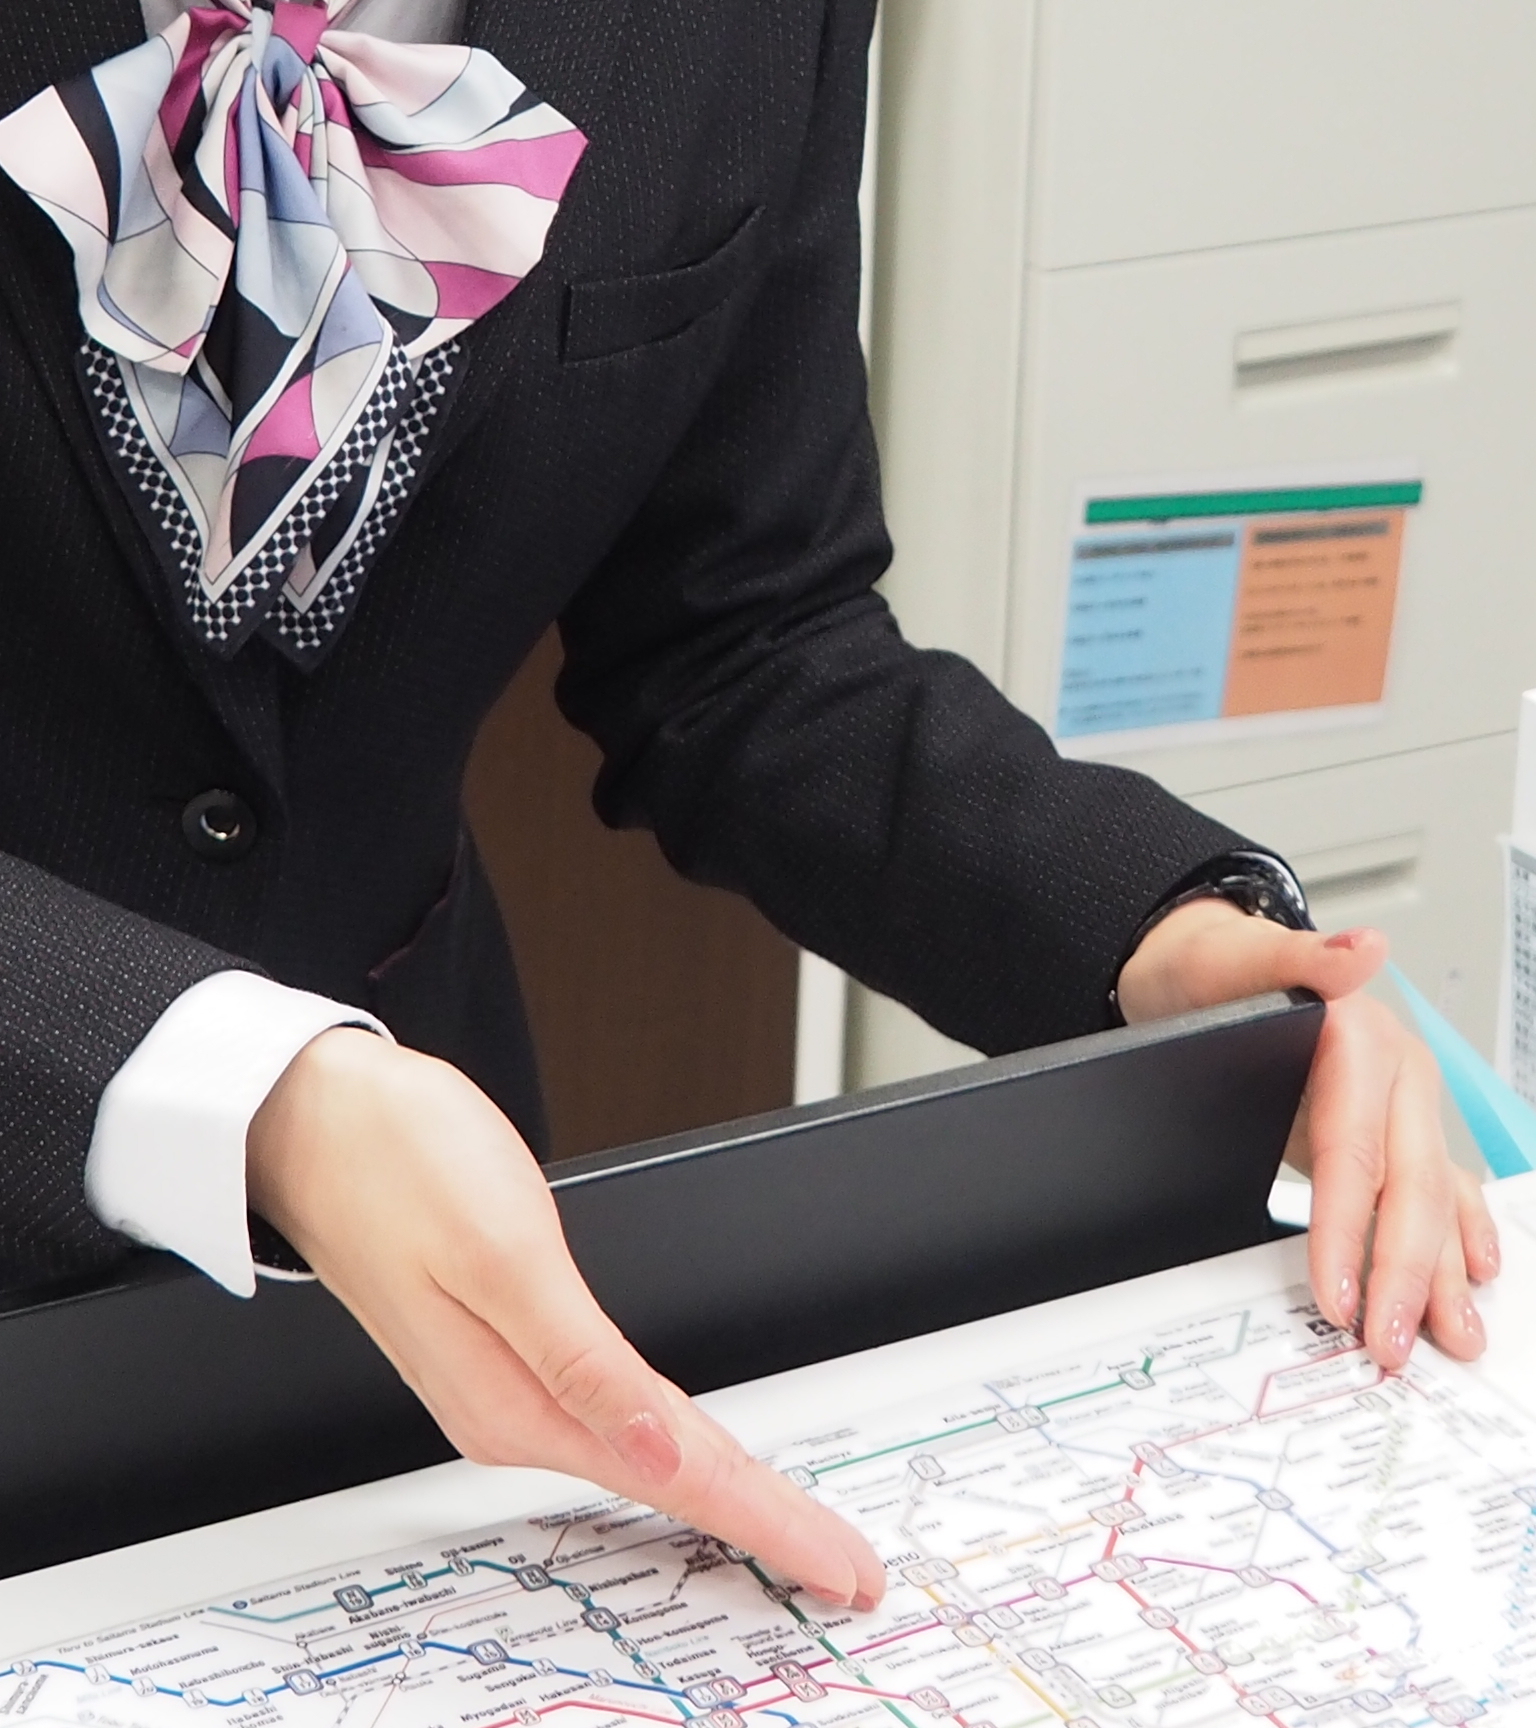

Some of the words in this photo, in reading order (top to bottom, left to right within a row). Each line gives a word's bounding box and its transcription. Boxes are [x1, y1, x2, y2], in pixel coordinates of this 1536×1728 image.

[1117, 1512, 1185, 1536] Asakusa
[439, 1534, 505, 1560] Oji-kamiya
[507, 1552, 527, 1566] Oji
[383, 1559, 425, 1577] Shimo
[588, 1566, 660, 1594] Nishigahara
[249, 1588, 293, 1607] Saitama
[293, 1575, 337, 1594] Stadium
[338, 1568, 362, 1582] Line
[348, 1585, 458, 1626] Akabane-iwabuchi
[621, 1599, 690, 1626] Komagome
[95, 1626, 138, 1644] Saitama
[139, 1614, 182, 1632] Stadium
[182, 1606, 206, 1620] Line
[555, 1615, 580, 1630] Line
[637, 1612, 730, 1647] Hon-komagome
[822, 1616, 853, 1630] Nezu
[84, 1632, 181, 1666] Shimura-sakaue
[363, 1630, 412, 1652] sugamo
[745, 1642, 787, 1661] Hongo-
[129, 1644, 220, 1678] Motohasunuma
[270, 1644, 355, 1676] Shin-itabashi
[658, 1646, 718, 1671] Todaimae
[755, 1643, 815, 1668] sanchome
[178, 1658, 266, 1691] Itabashihoncho
[455, 1662, 507, 1684] Sugamo
[484, 1670, 538, 1694] Sengoku
[677, 1665, 723, 1686] Kasuga
[538, 1680, 593, 1704] Hakusan
[460, 1697, 528, 1724] Myogadani
